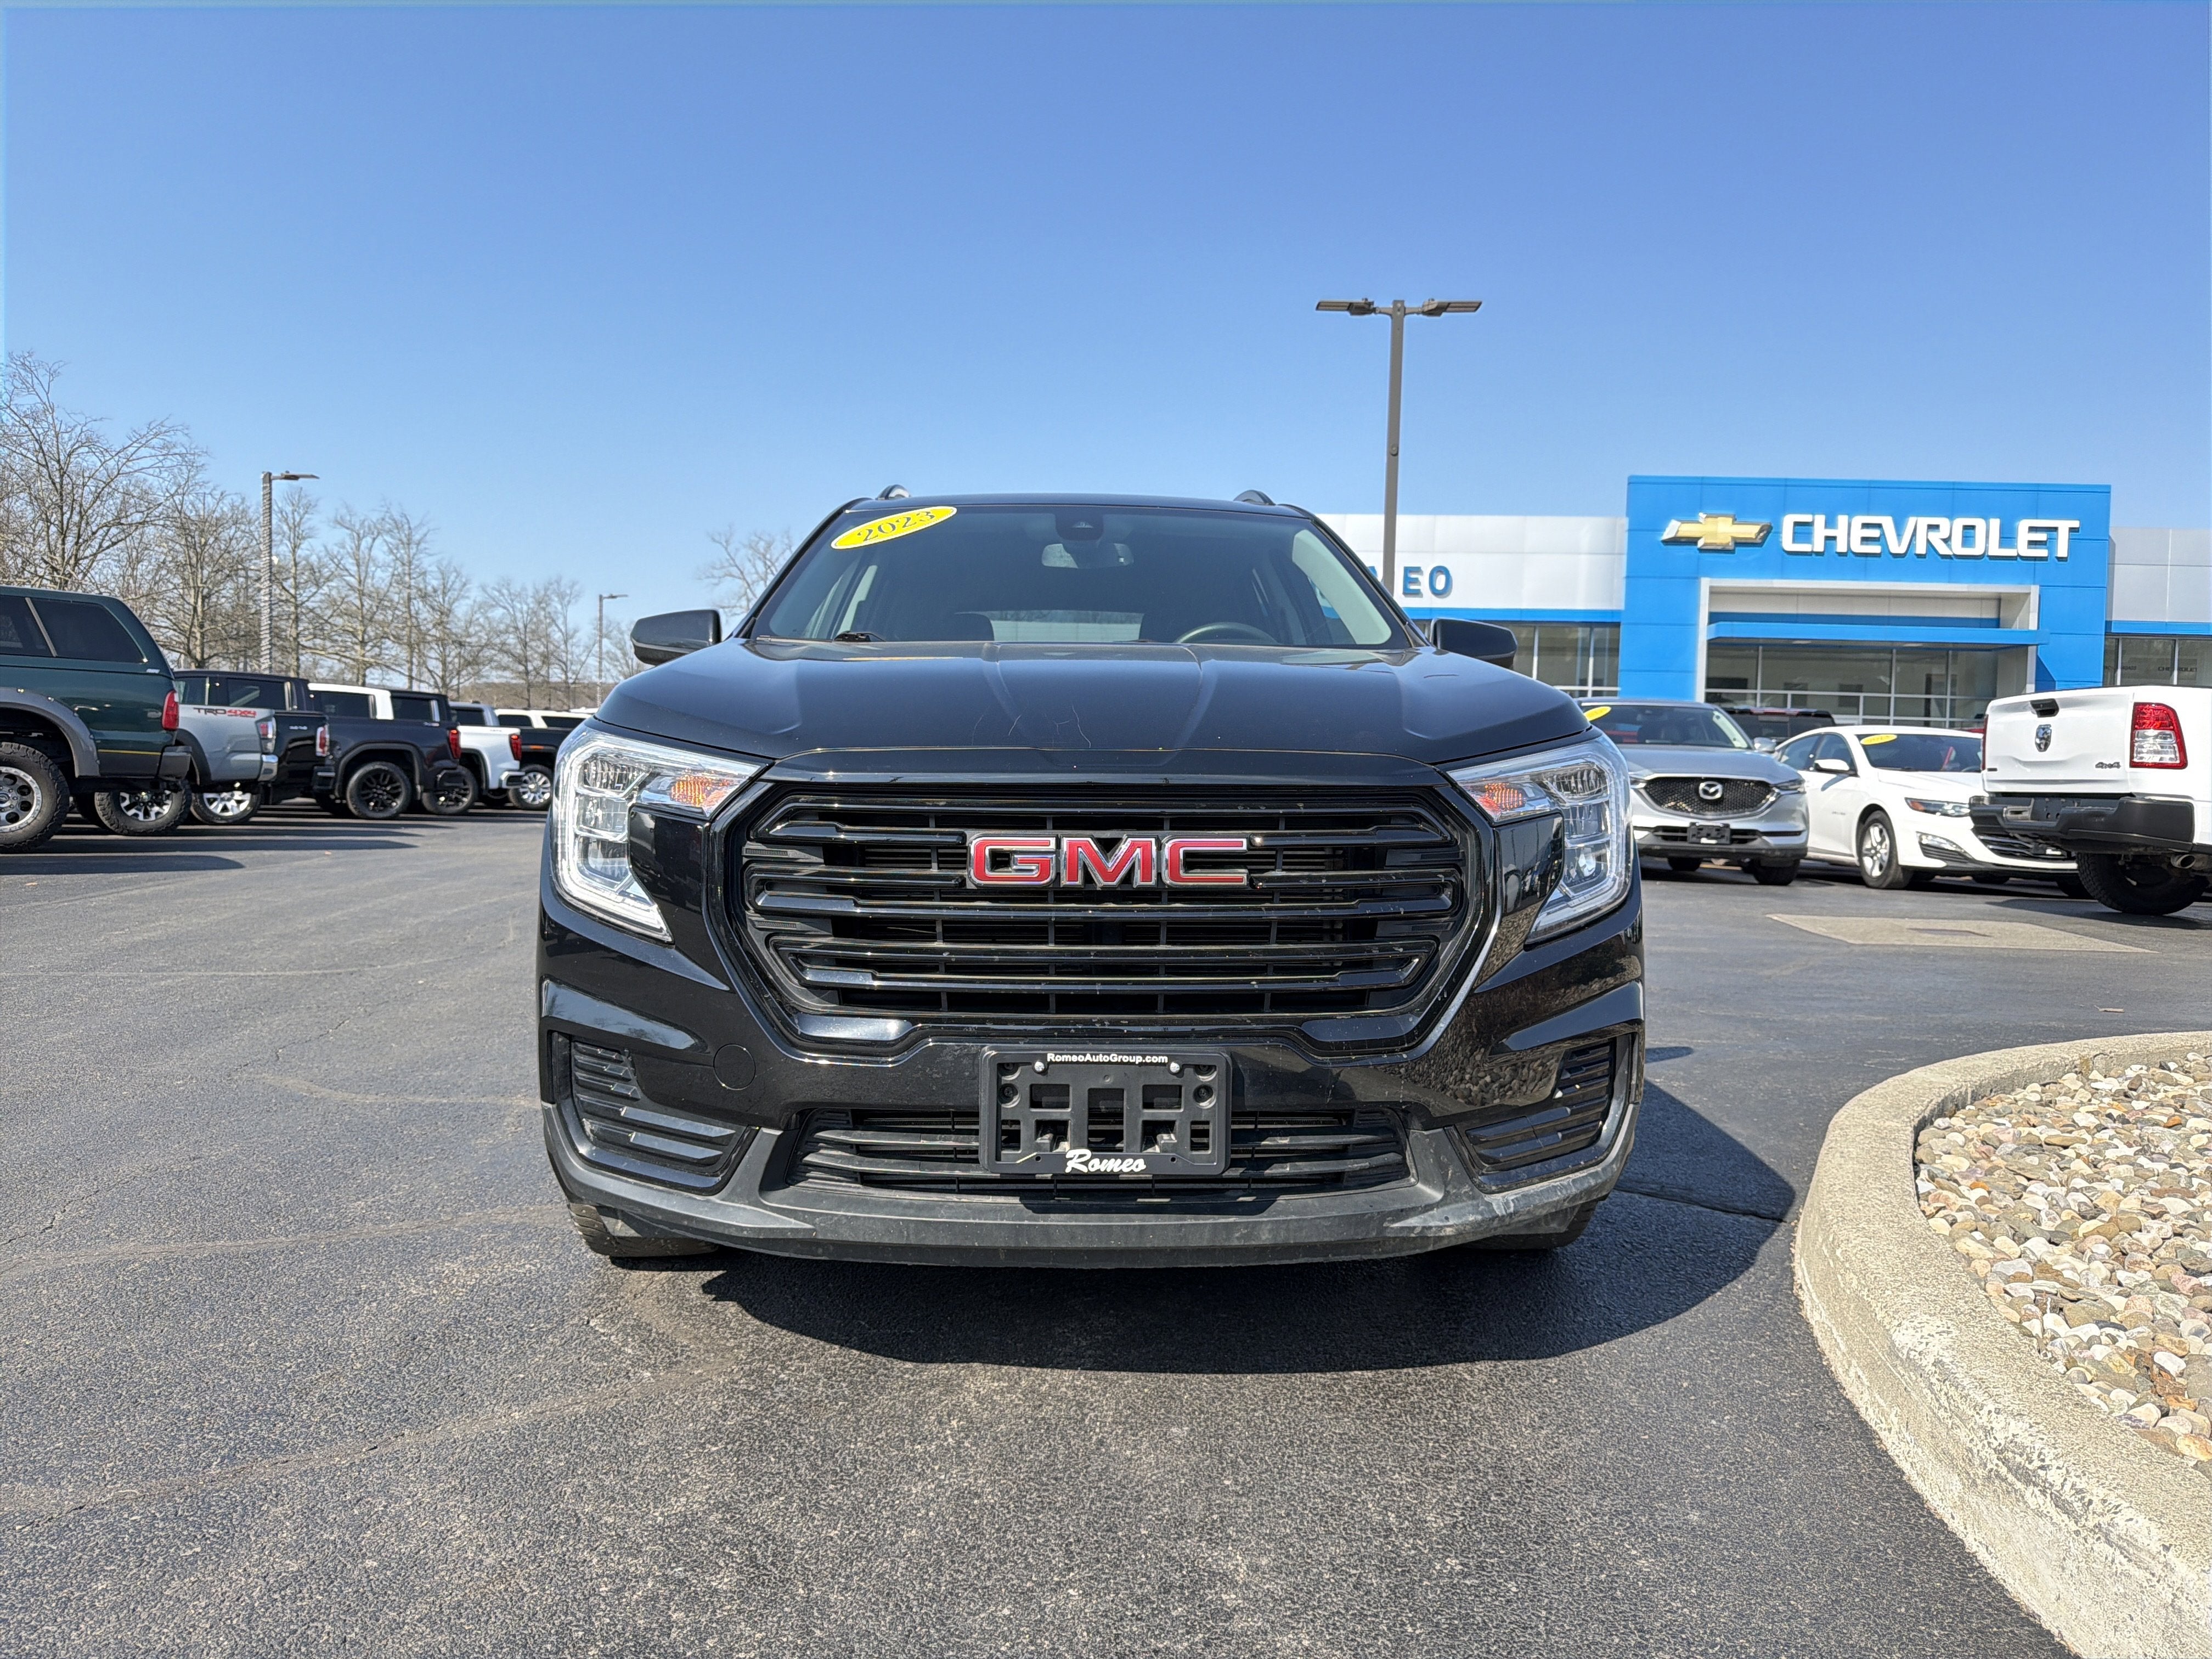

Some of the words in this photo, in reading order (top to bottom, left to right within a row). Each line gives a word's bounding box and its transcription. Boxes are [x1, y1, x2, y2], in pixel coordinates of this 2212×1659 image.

[856, 511, 935, 542] 2023
[1781, 513, 2080, 560] CHEVROLET
[968, 834, 1250, 888] GMC
[1046, 1052, 1169, 1065] RomeoAutoGroup.com
[1064, 1148, 1147, 1173] Romeo
